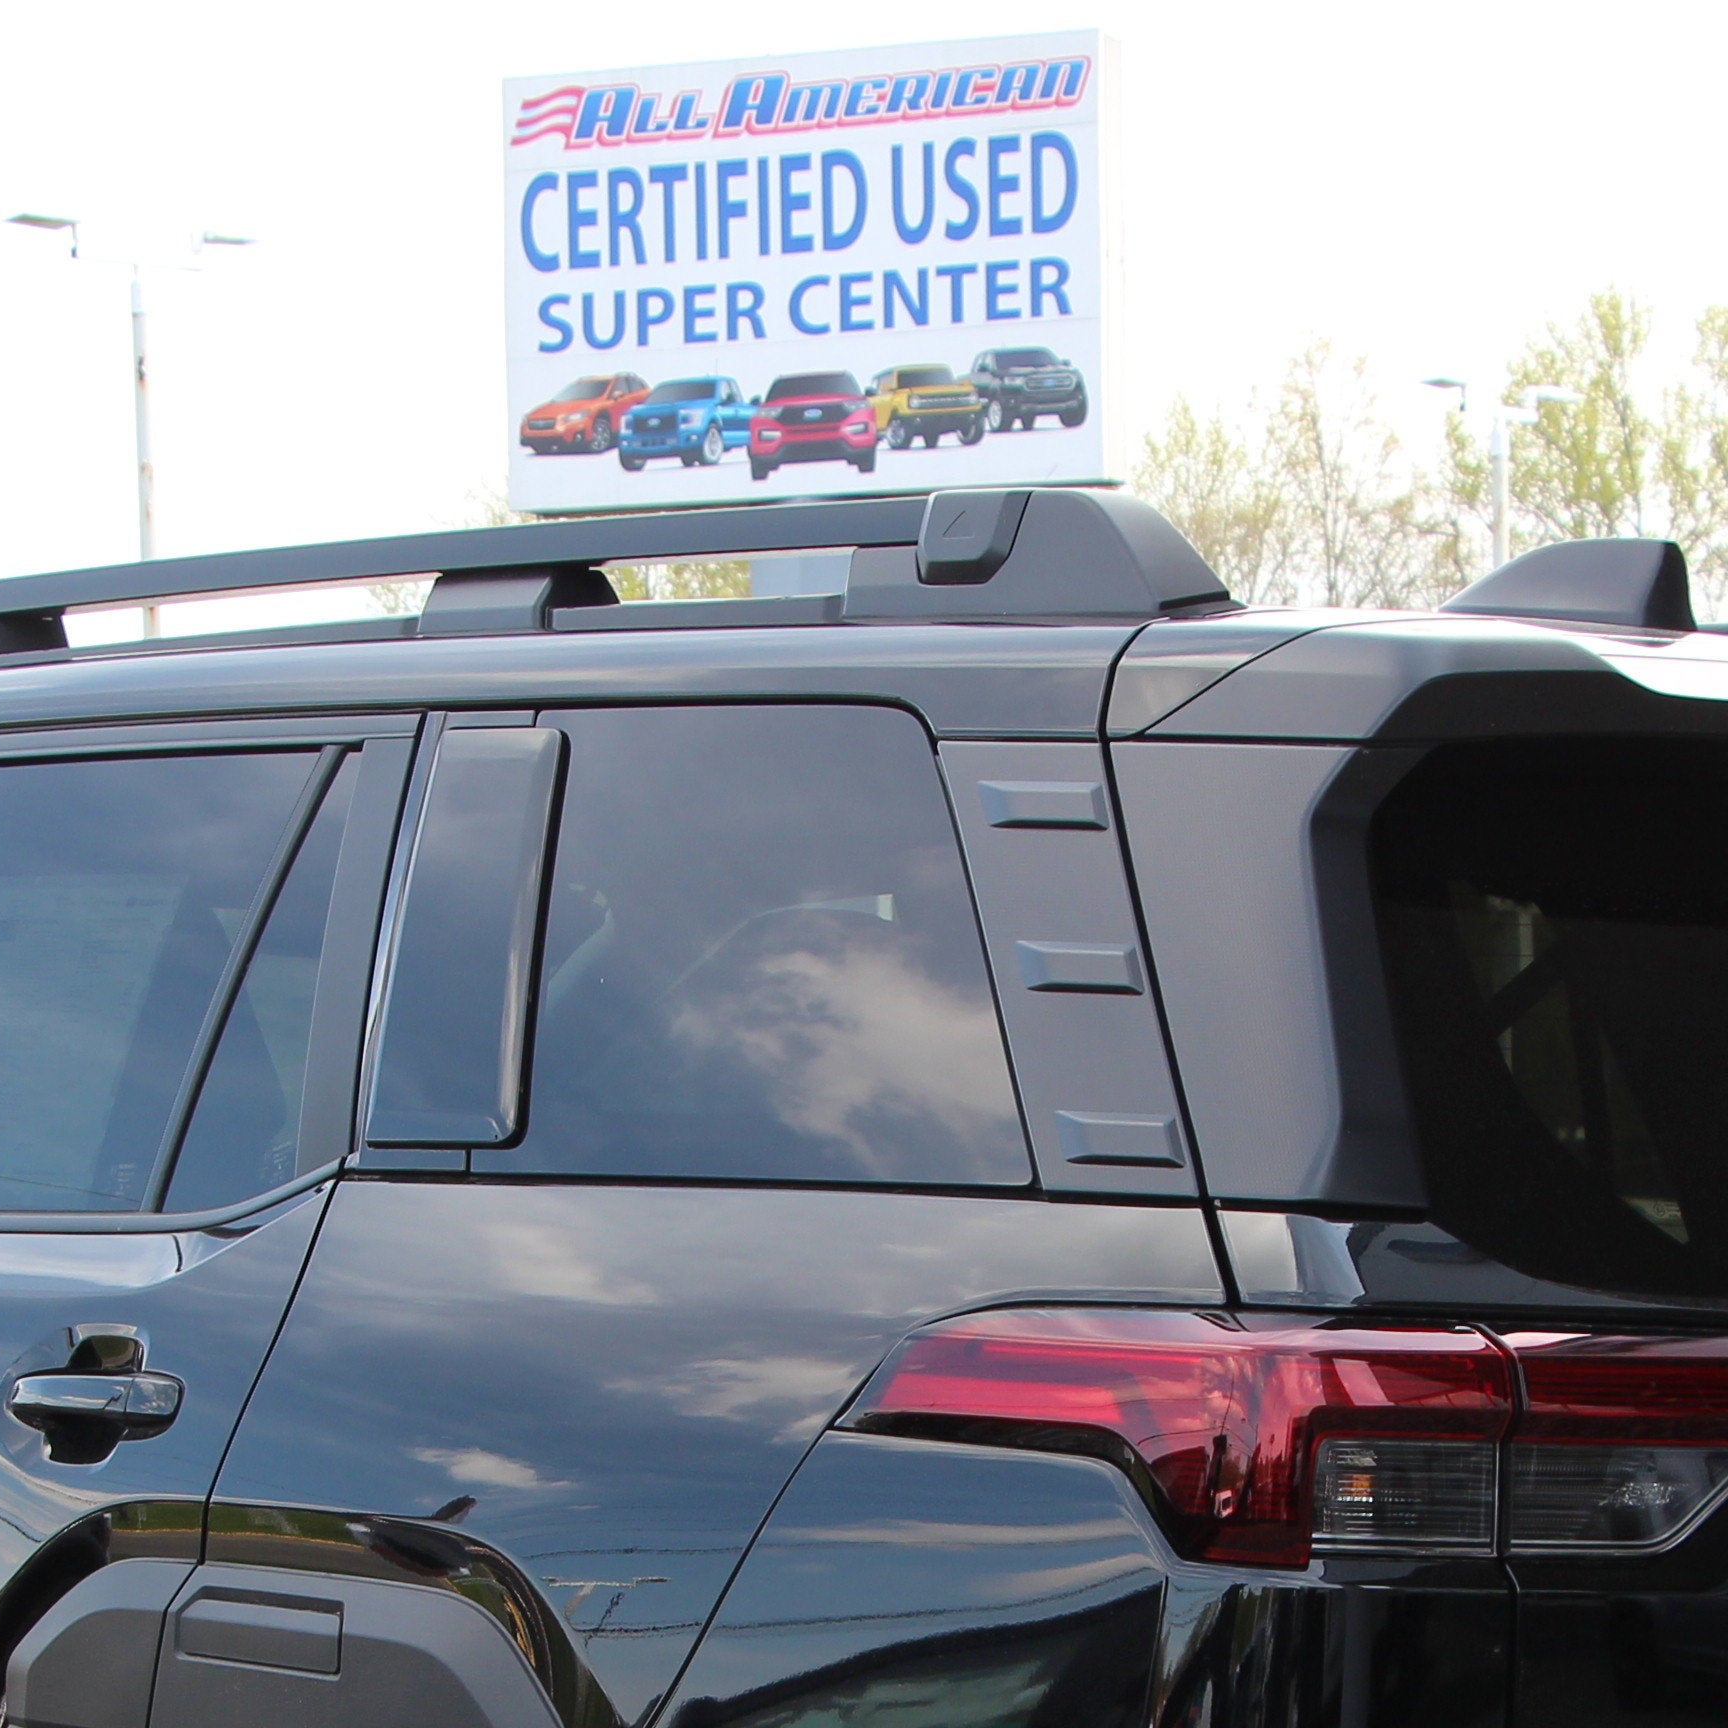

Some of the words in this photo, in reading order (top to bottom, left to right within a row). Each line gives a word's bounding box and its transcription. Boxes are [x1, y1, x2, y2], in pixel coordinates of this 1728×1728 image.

[520, 148, 867, 272] CERTIFIED
[891, 130, 1078, 245] USED
[537, 281, 766, 353] SUPER
[788, 257, 1072, 336] CENTER
